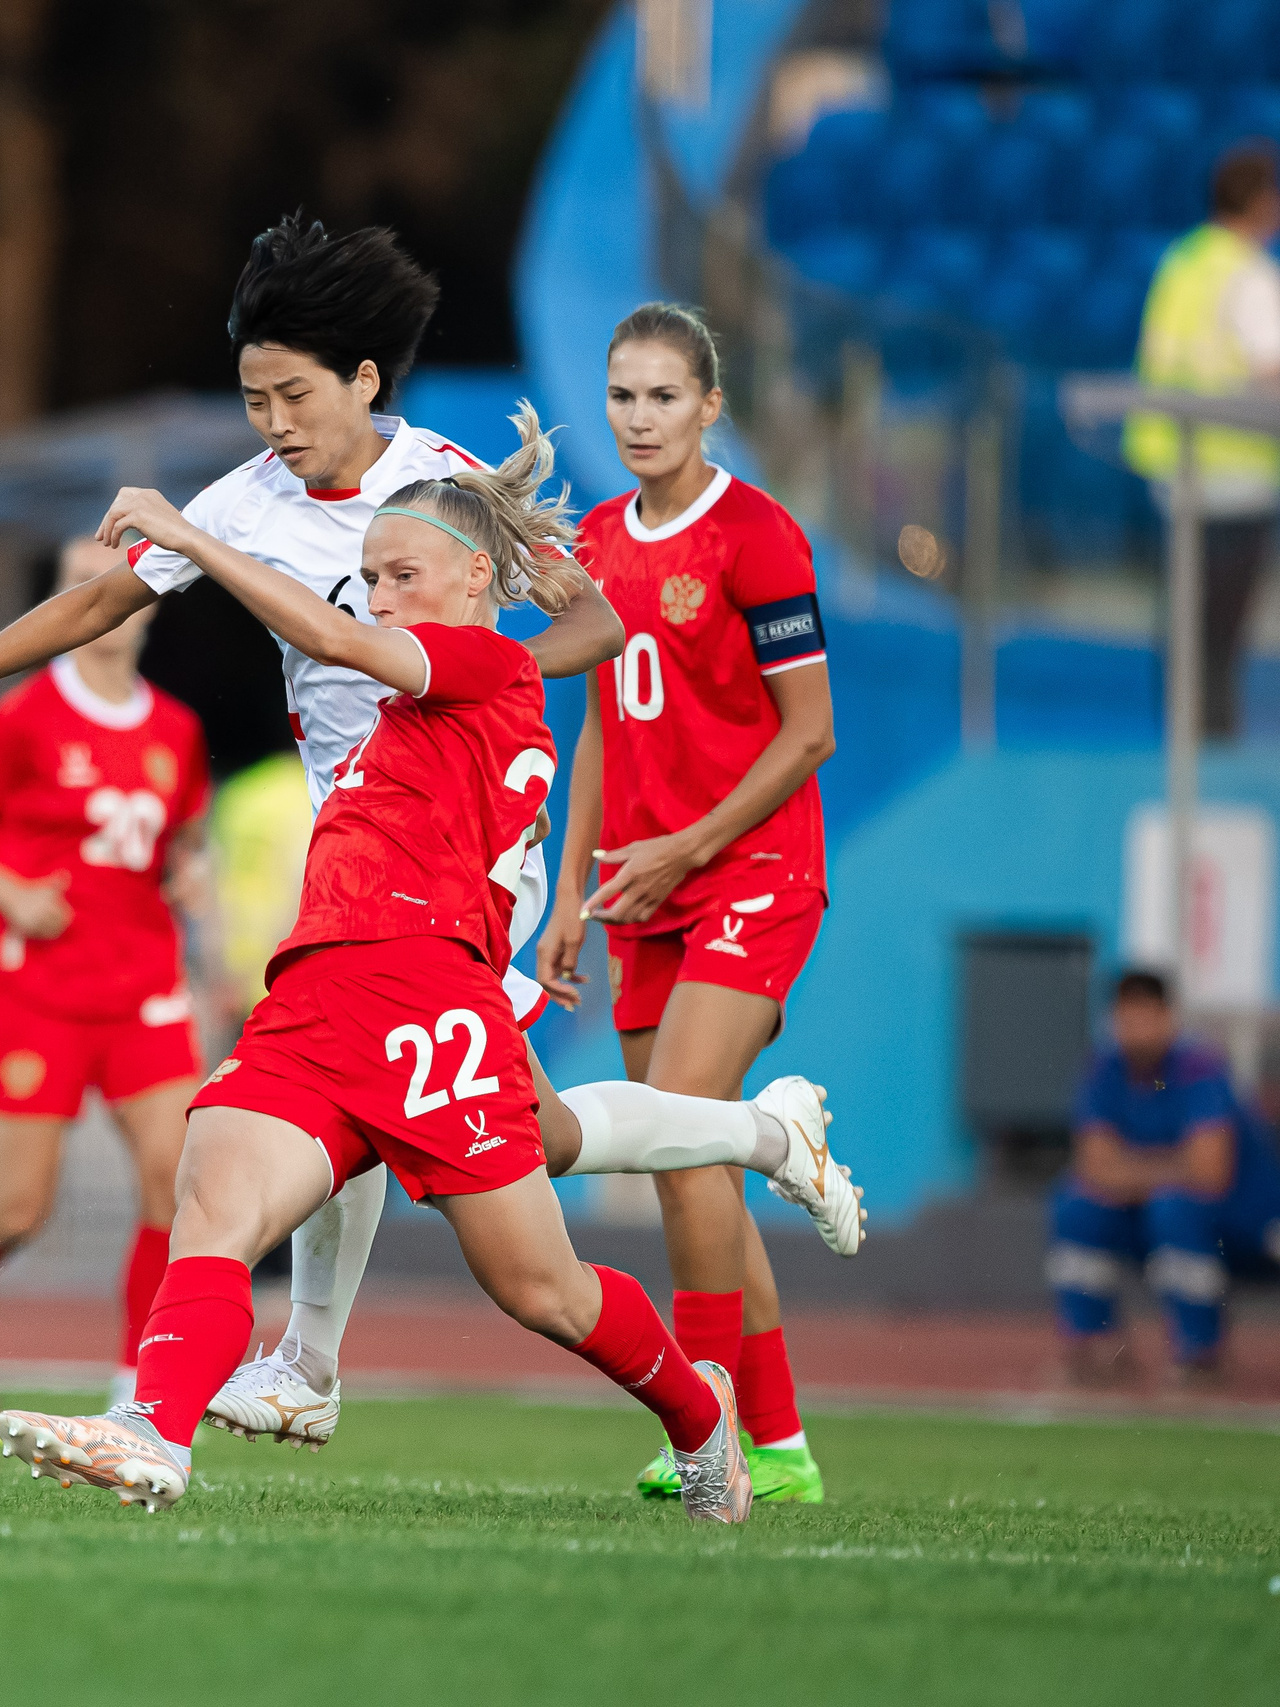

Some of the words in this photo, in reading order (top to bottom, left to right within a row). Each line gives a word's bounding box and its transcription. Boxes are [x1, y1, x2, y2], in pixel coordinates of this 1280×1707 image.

[768, 615, 814, 640] RESPECT
[385, 1008, 500, 1119] 22
[464, 1135, 508, 1158] JÖGEL
